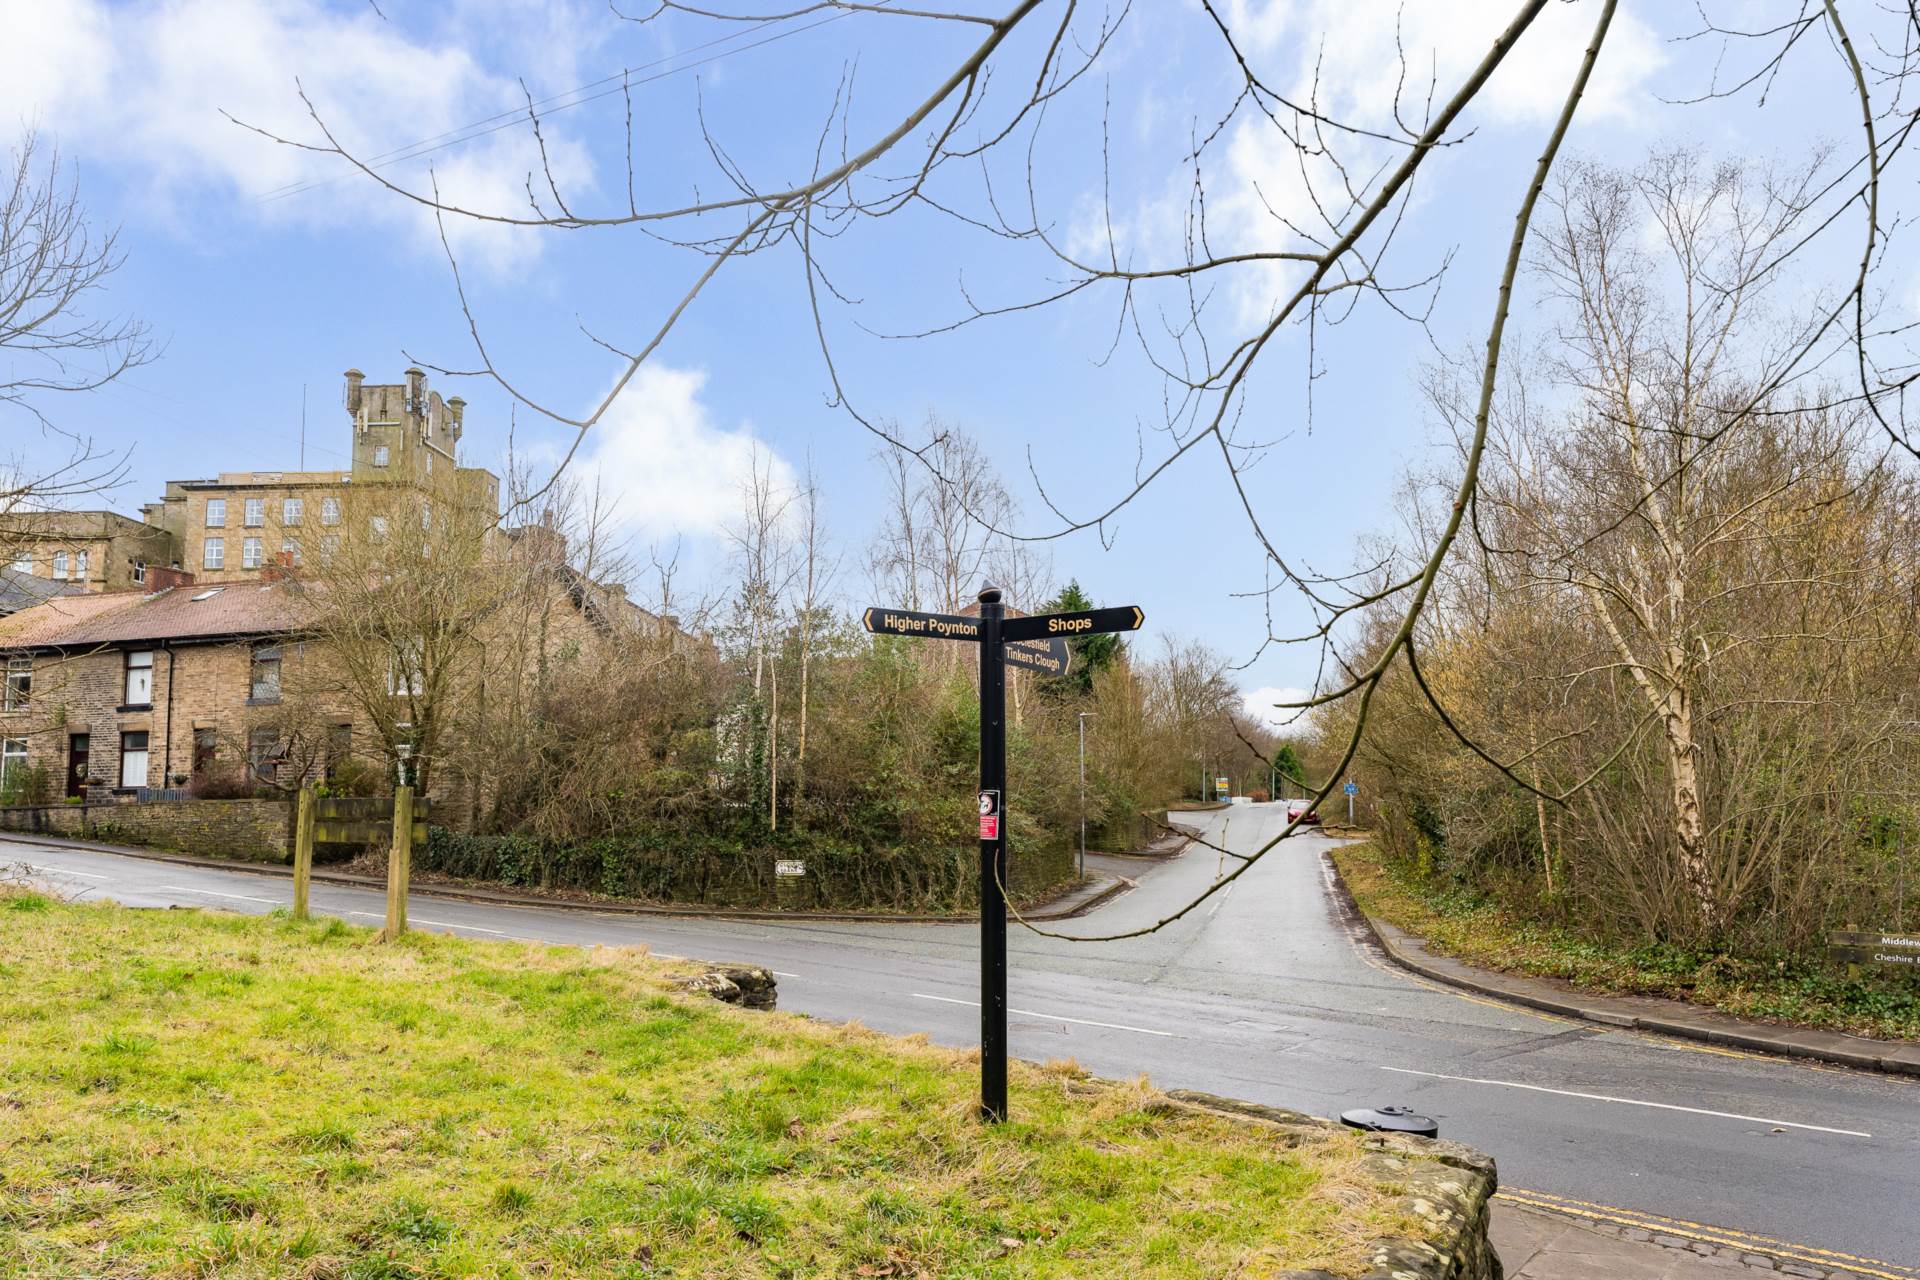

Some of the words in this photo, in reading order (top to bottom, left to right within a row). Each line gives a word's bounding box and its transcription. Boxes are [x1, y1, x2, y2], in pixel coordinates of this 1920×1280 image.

[884, 614, 926, 632] Higher
[929, 619, 977, 636] Poynton
[1048, 618, 1092, 632] Shops
[1006, 646, 1033, 664] Tinkers
[1035, 653, 1060, 671] Clough
[1874, 953, 1913, 963] Cheshire
